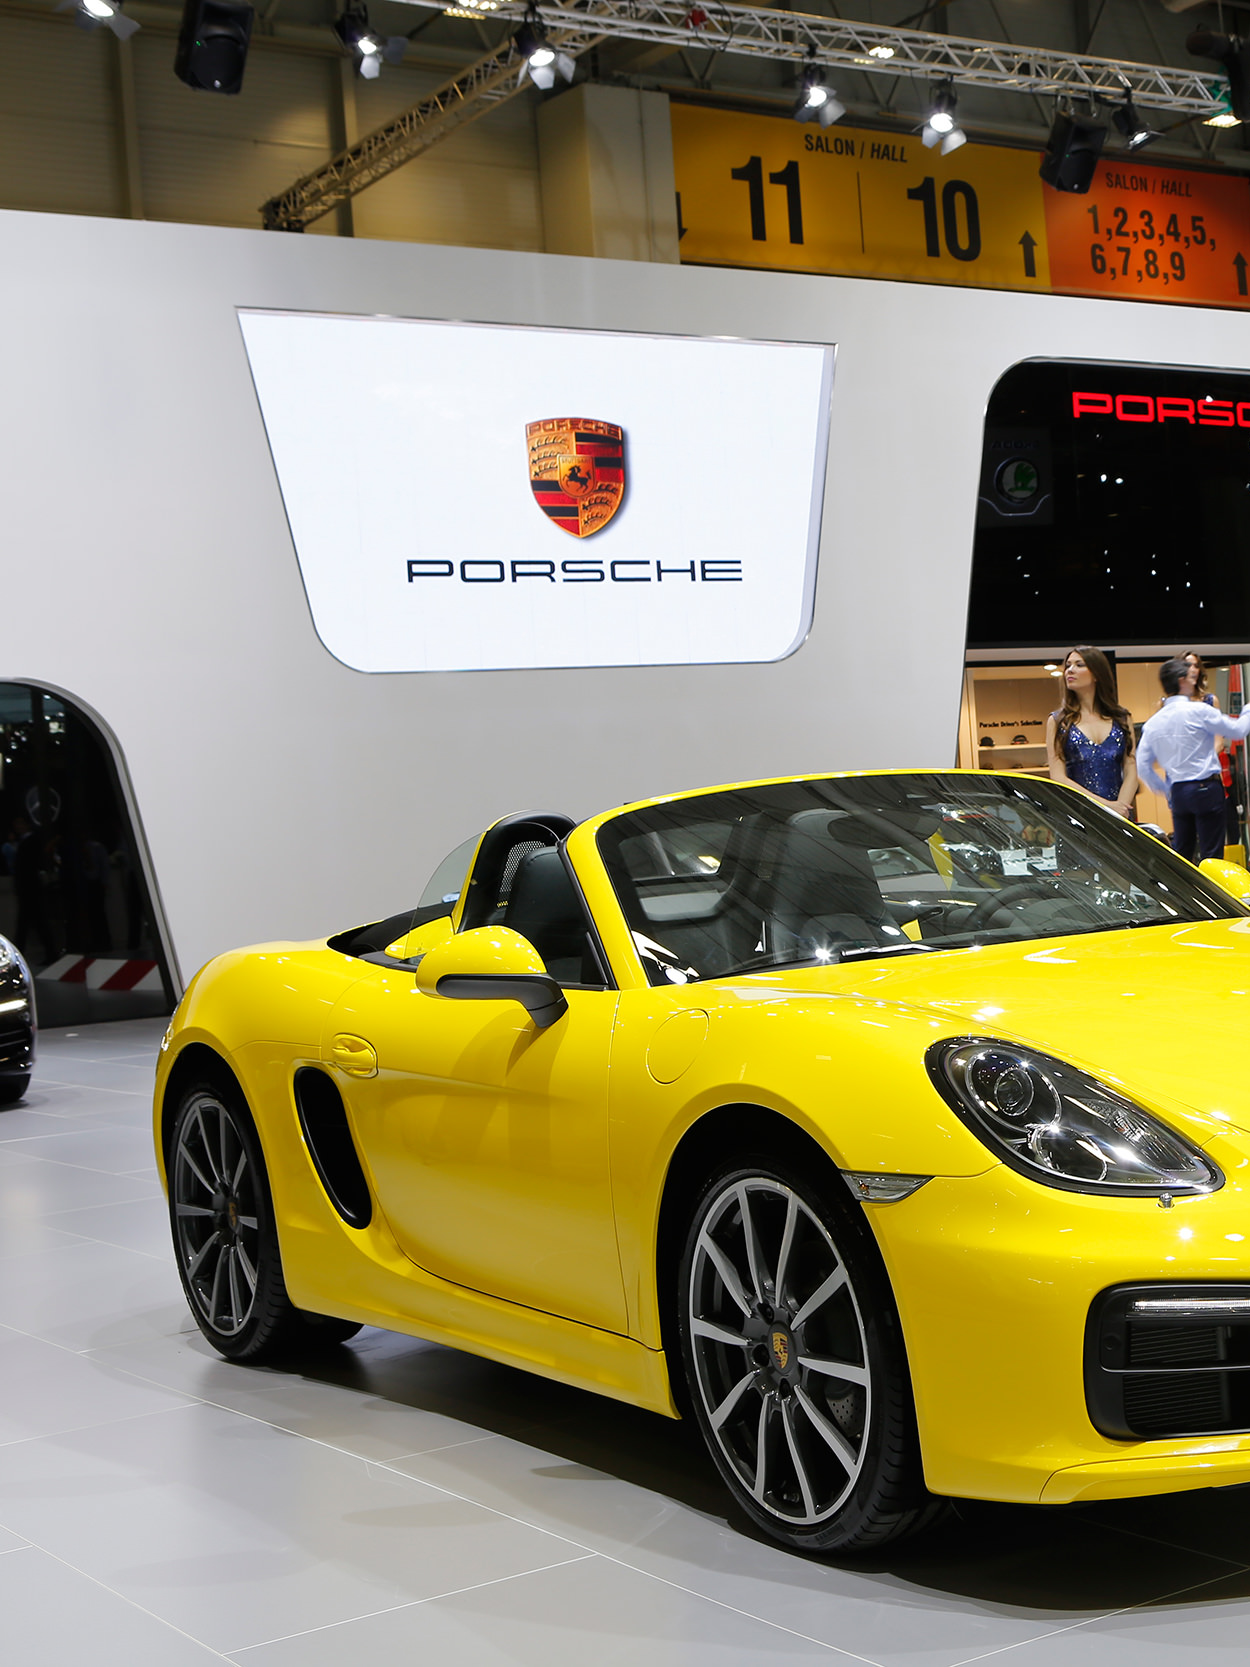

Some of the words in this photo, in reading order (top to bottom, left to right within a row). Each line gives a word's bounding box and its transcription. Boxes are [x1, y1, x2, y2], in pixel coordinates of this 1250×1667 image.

[804, 133, 855, 157] SALON
[870, 142, 908, 163] HALL
[731, 155, 804, 245] 11
[1105, 172, 1148, 192] SALON
[1160, 179, 1192, 198] HALL
[907, 176, 982, 262] 10
[1087, 204, 1216, 251] 1,2,3,4,5,
[1090, 243, 1186, 285] 6,7,8,9
[407, 559, 743, 583] PORSCHE
